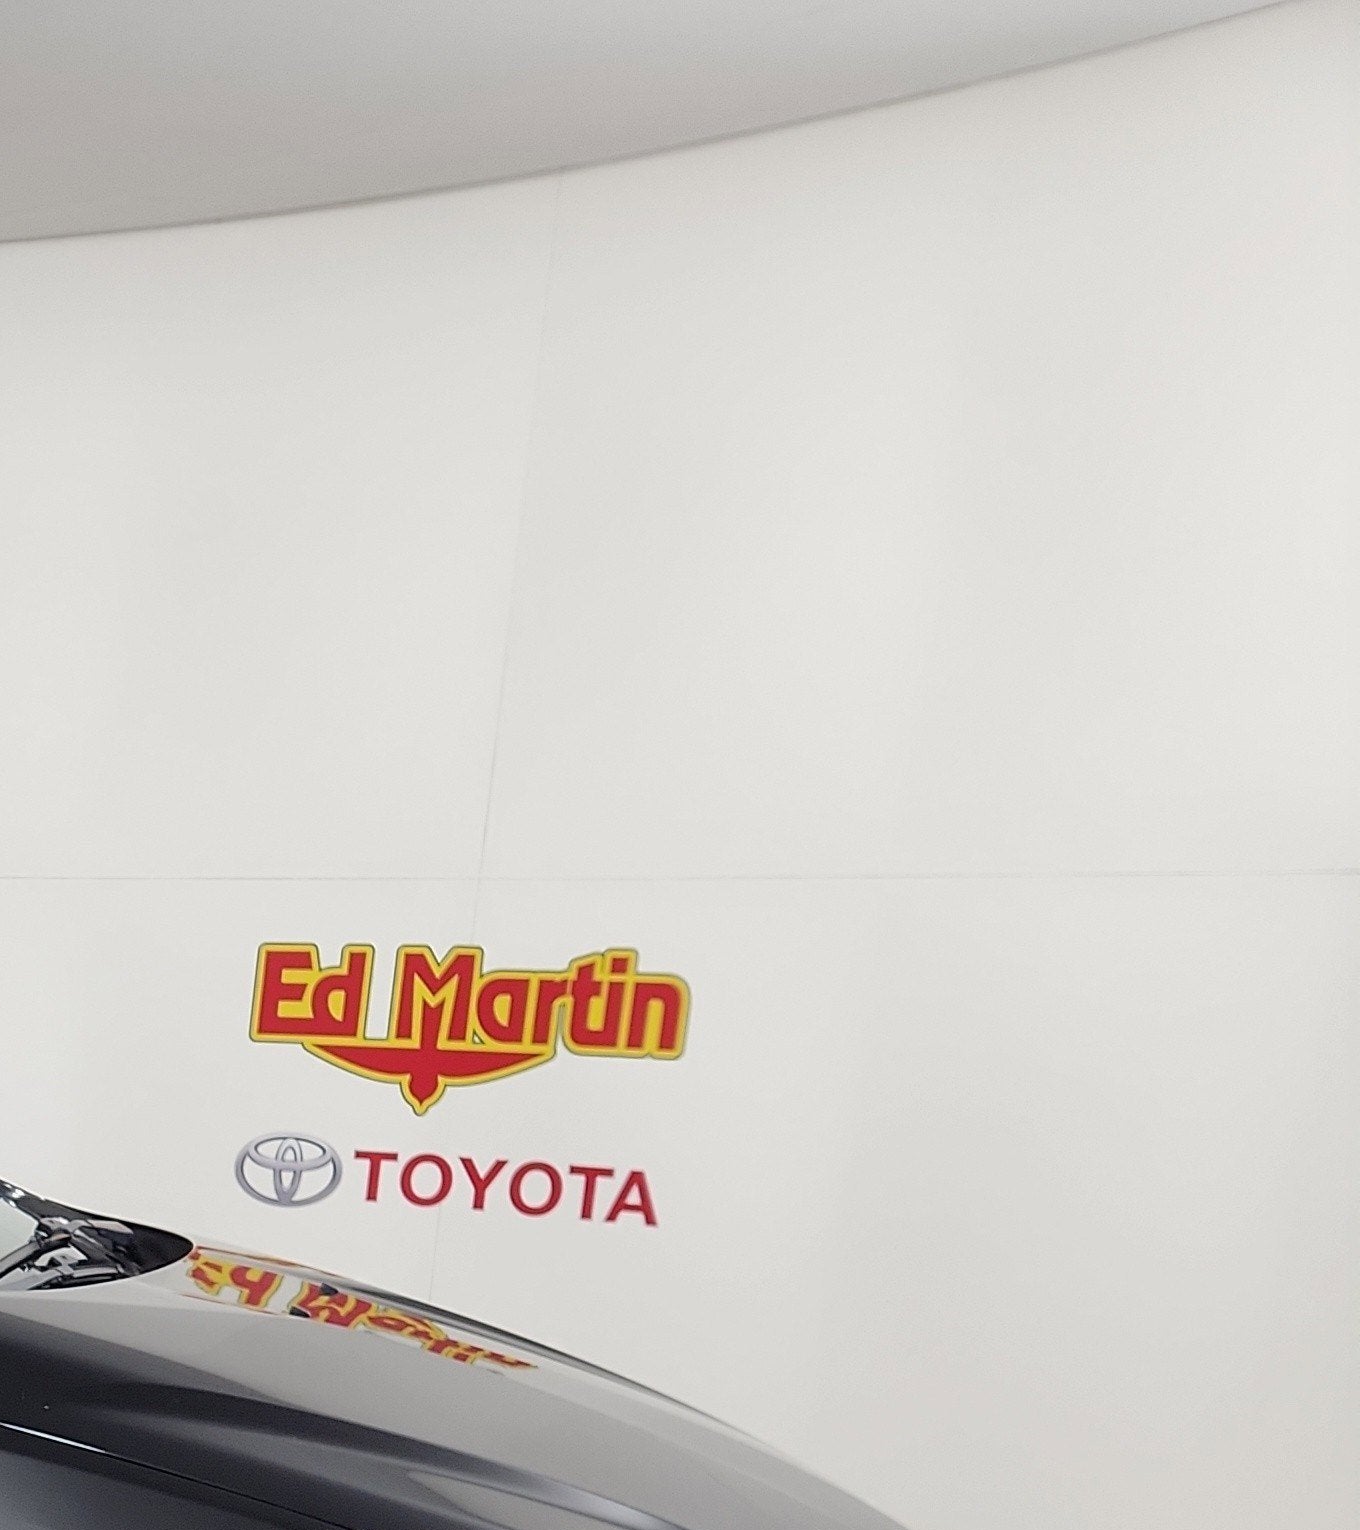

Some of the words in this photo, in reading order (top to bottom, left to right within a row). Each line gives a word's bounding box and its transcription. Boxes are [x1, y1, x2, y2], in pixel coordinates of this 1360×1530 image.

[253, 946, 370, 1040] Ed
[392, 948, 684, 1053] Martin
[354, 1149, 659, 1227] TOYOTA
